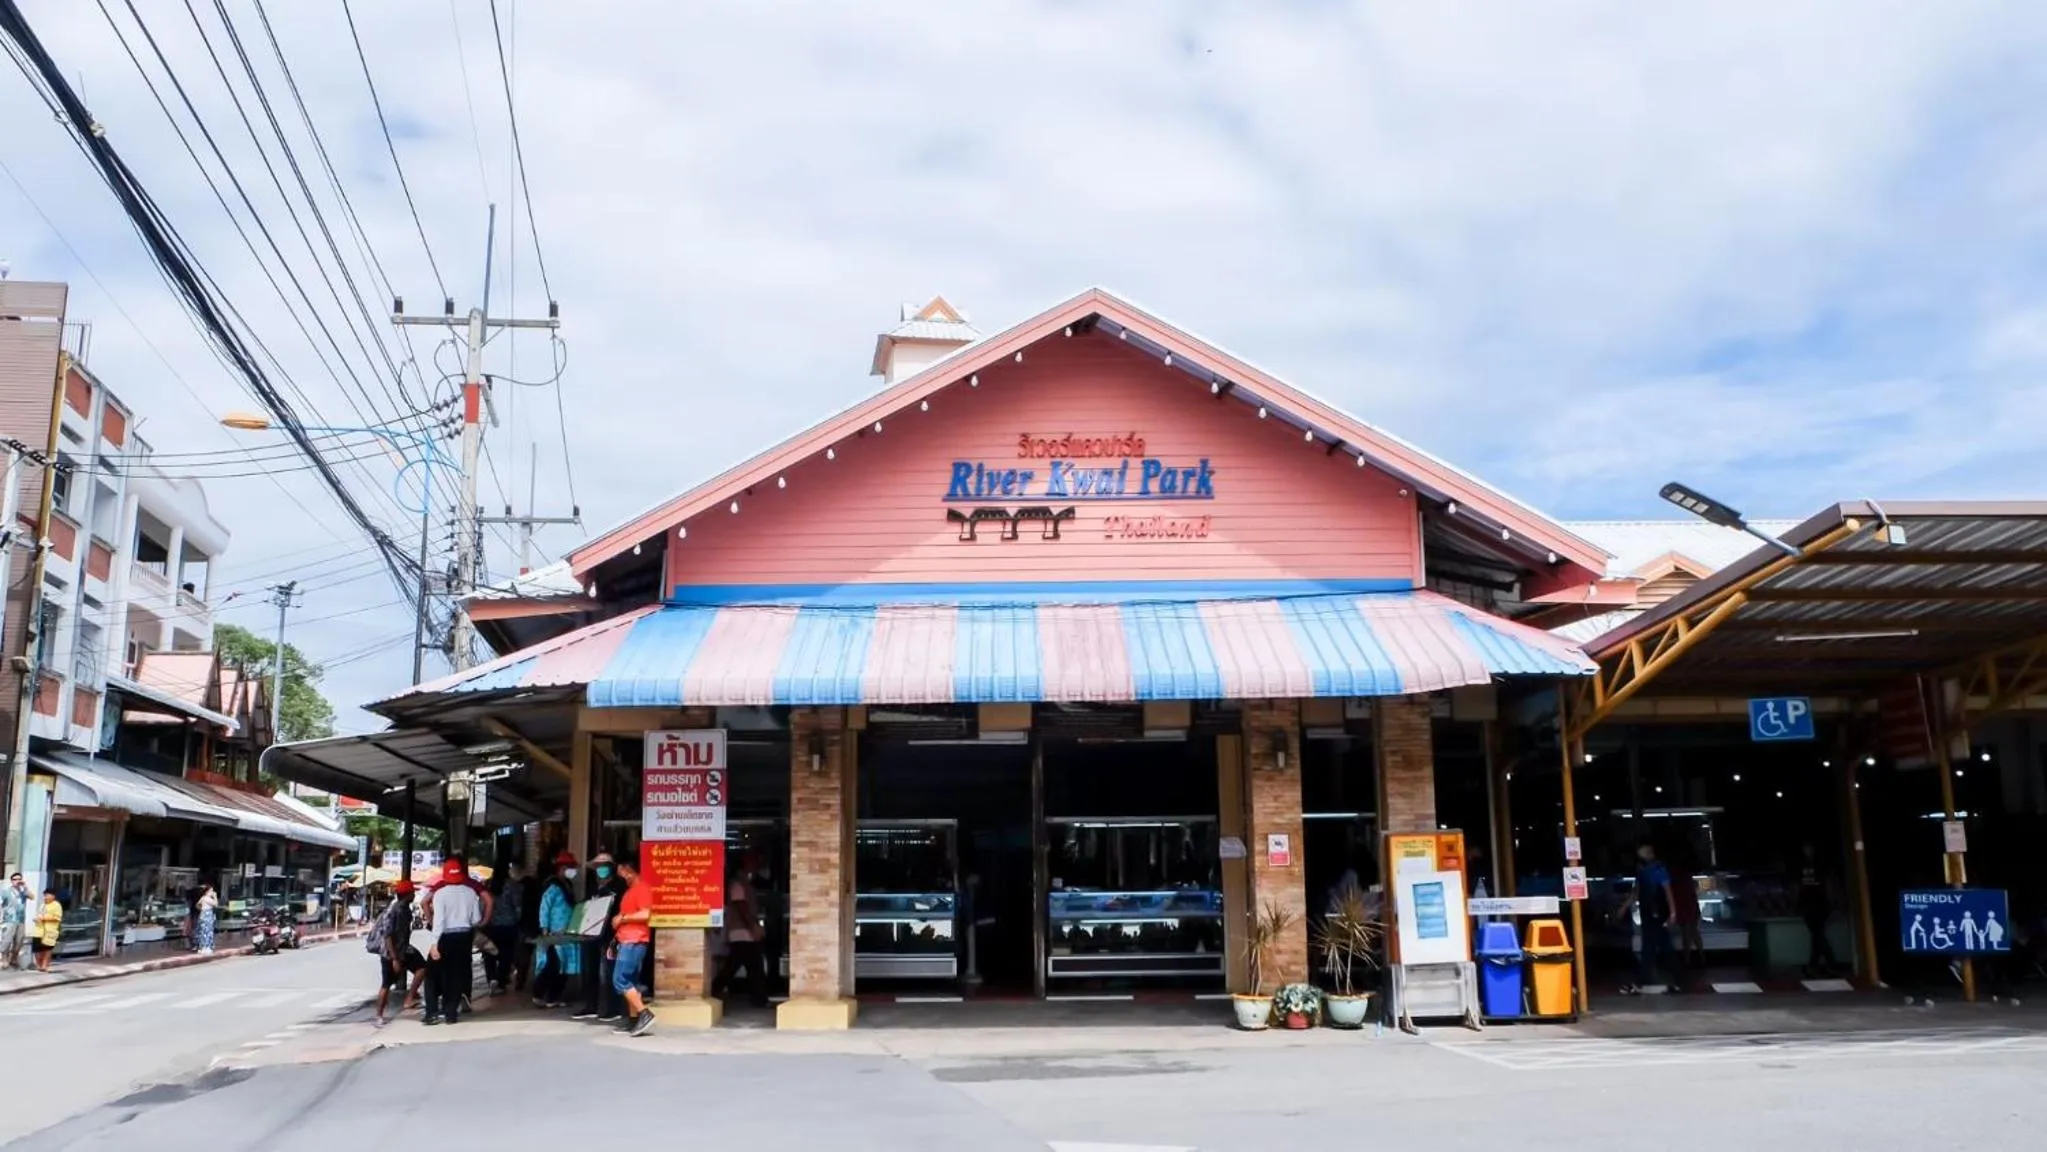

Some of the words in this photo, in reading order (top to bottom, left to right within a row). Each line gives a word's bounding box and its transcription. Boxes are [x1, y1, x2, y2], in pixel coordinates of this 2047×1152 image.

[947, 460, 1035, 497] River
[1046, 459, 1129, 496] Kwai
[1139, 458, 1216, 496] Park
[1104, 515, 1212, 538] Thailand
[1786, 700, 1807, 724] P
[657, 733, 713, 765] ห้าม
[1903, 893, 1962, 904] FRIENDLY
